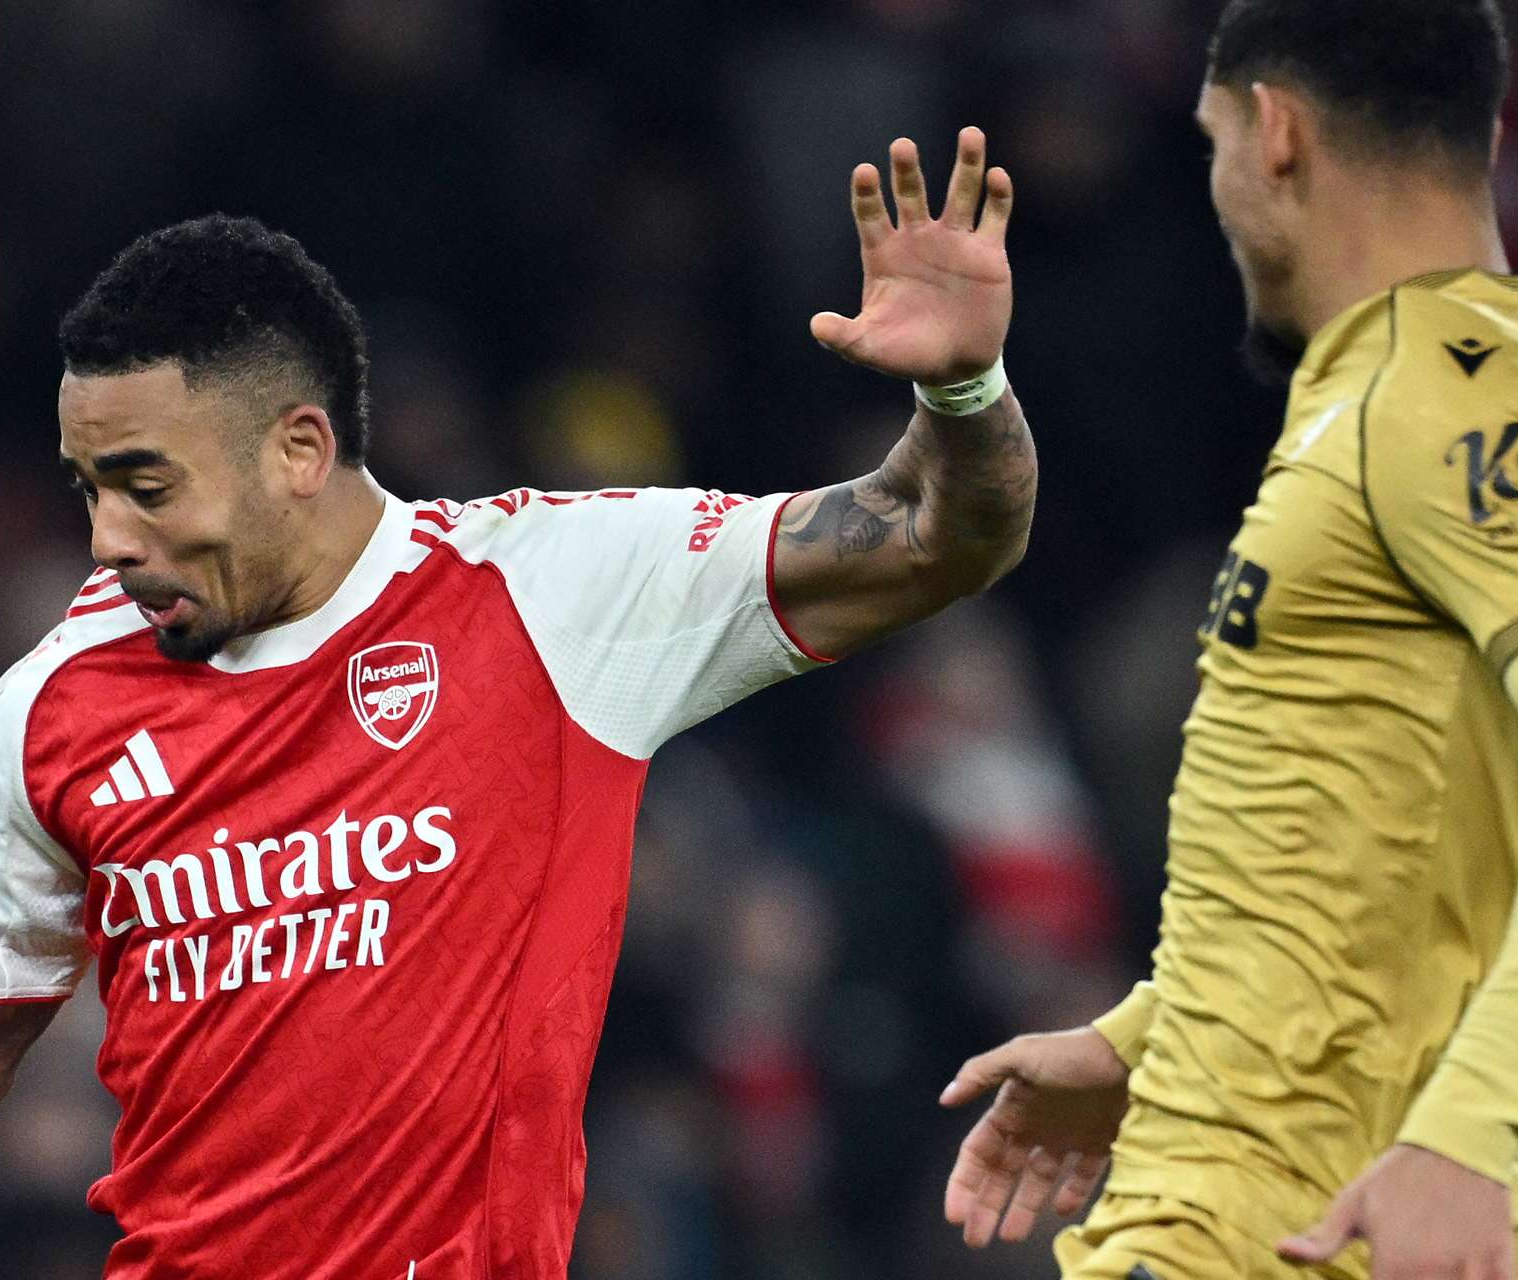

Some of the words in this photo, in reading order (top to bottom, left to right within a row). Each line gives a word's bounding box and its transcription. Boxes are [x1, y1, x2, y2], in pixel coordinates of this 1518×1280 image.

[360, 656, 425, 684] Arsenal
[92, 805, 457, 938] Emirates
[144, 933, 210, 1003] FLY
[219, 898, 391, 992] BETTER
